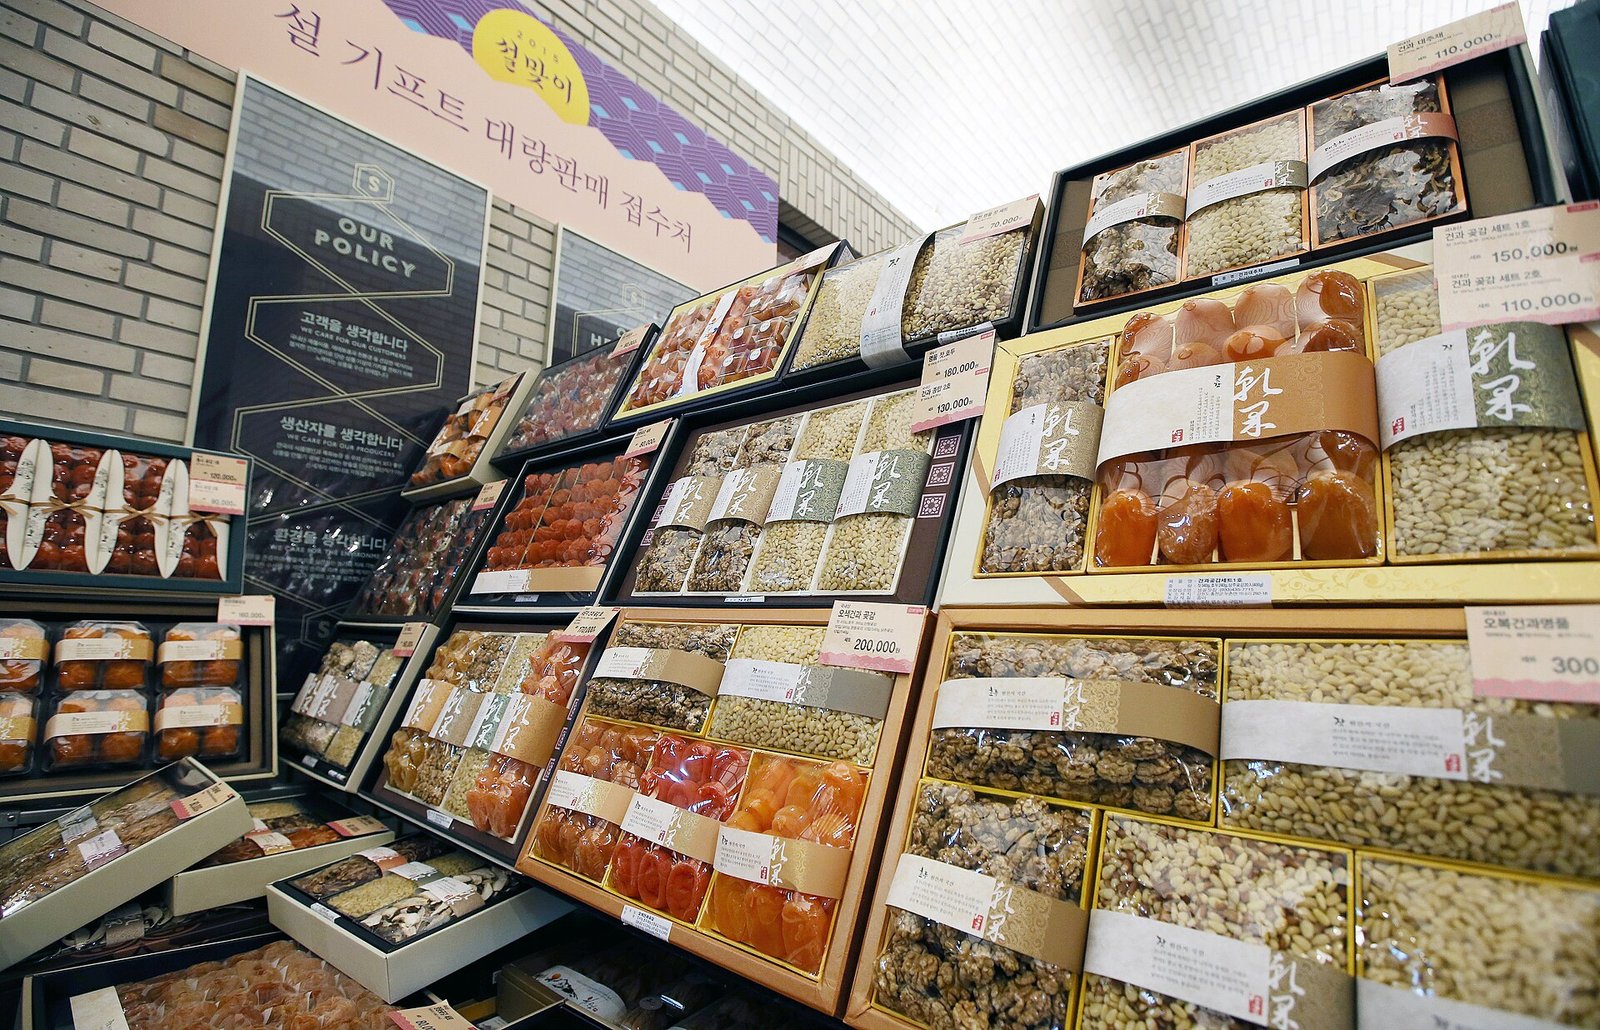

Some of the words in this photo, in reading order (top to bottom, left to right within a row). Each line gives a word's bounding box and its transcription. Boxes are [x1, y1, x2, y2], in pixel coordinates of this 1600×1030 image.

[517, 31, 559, 63] 2015
[496, 38, 572, 103] 설맞이
[273, 3, 321, 57] 설
[341, 40, 470, 132] 기프트
[485, 118, 609, 210] 대량판매
[620, 191, 692, 253] 접수처
[368, 175, 380, 192] S
[338, 217, 394, 251] OUR
[1491, 222, 1512, 233] 세트
[1515, 219, 1531, 229] 1호
[314, 229, 416, 278] POLICY
[300, 311, 342, 334] 고객을
[346, 323, 408, 352] 생각합니다
[300, 326, 311, 335] WE
[314, 329, 333, 341] CARE
[336, 334, 350, 345] FOR
[352, 339, 366, 349] OUR
[368, 343, 407, 360] CUSTOMERS
[280, 416, 337, 437] 생산자를
[341, 426, 404, 451] 생각합니다
[287, 433, 296, 441] WE
[299, 436, 320, 445] CARE
[323, 439, 337, 448] FOR
[340, 442, 354, 451] OUR
[356, 444, 396, 459] PRODUCERS
[274, 528, 317, 545] 환경을
[321, 533, 387, 551] 생각합니다
[838, 609, 862, 619] 오색건과
[862, 610, 876, 621] 곶감
